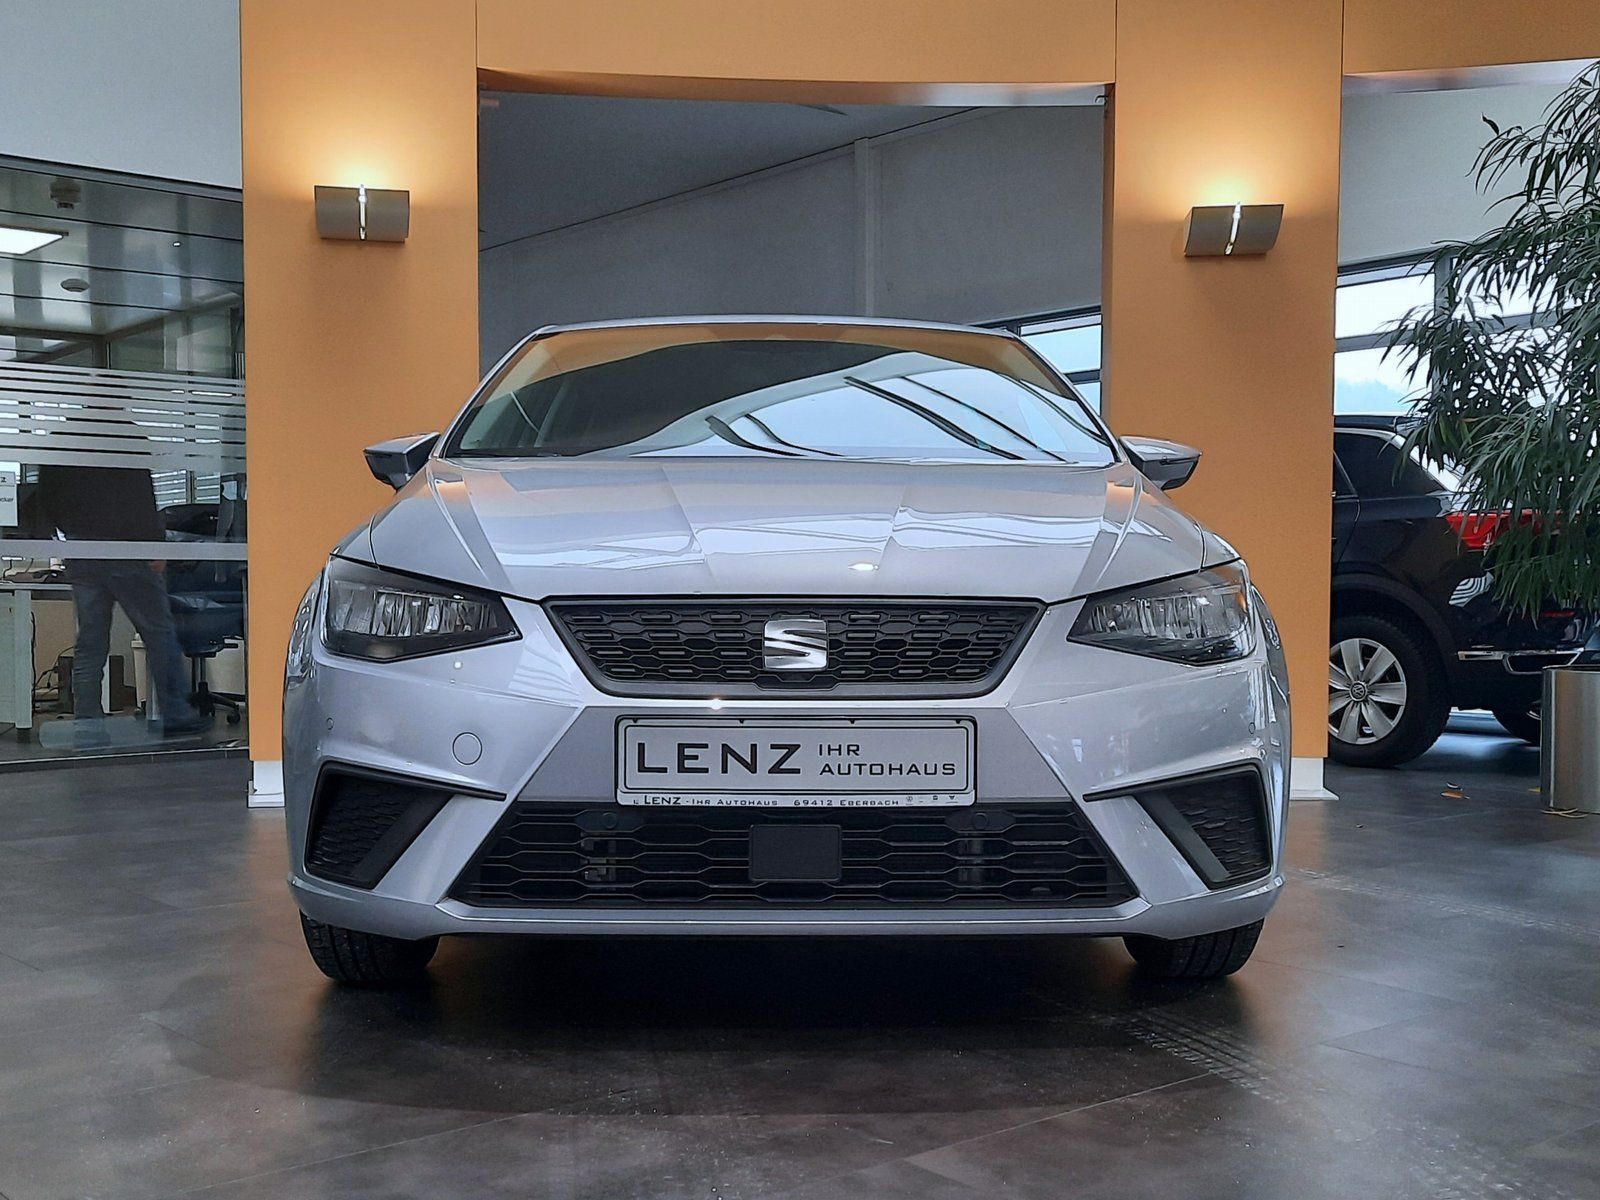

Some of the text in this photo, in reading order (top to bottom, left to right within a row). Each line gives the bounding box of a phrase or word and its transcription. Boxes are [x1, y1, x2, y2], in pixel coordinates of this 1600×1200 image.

[819, 743, 860, 757] IHR
[637, 742, 802, 775] LENZ
[819, 762, 956, 776] AUTOHAUS
